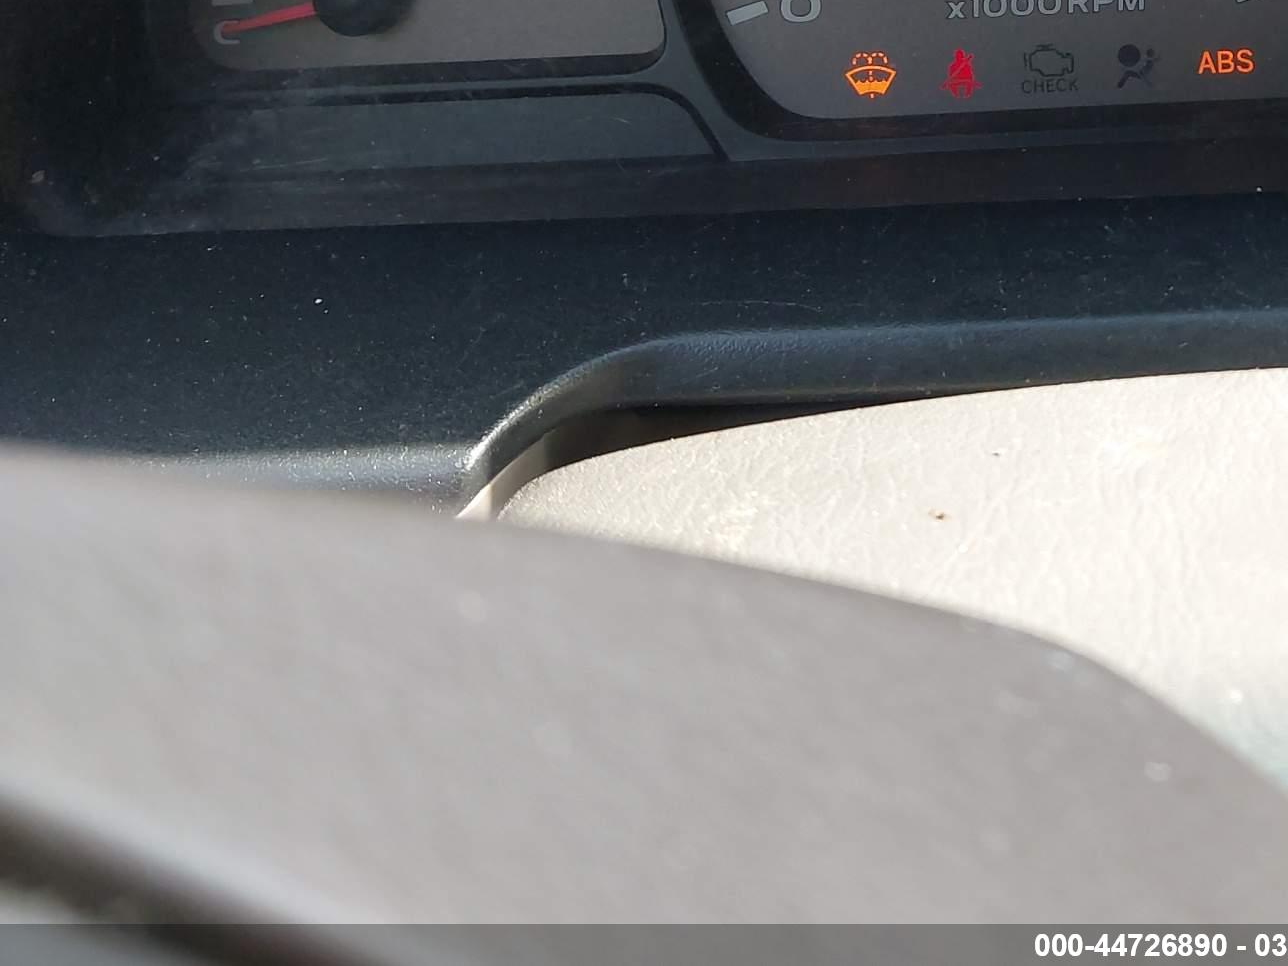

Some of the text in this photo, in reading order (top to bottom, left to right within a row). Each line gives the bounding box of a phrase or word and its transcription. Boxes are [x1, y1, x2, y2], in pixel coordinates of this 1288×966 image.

[214, 18, 241, 45] C
[1198, 48, 1256, 76] ABS
[1020, 74, 1080, 96] CHECK
